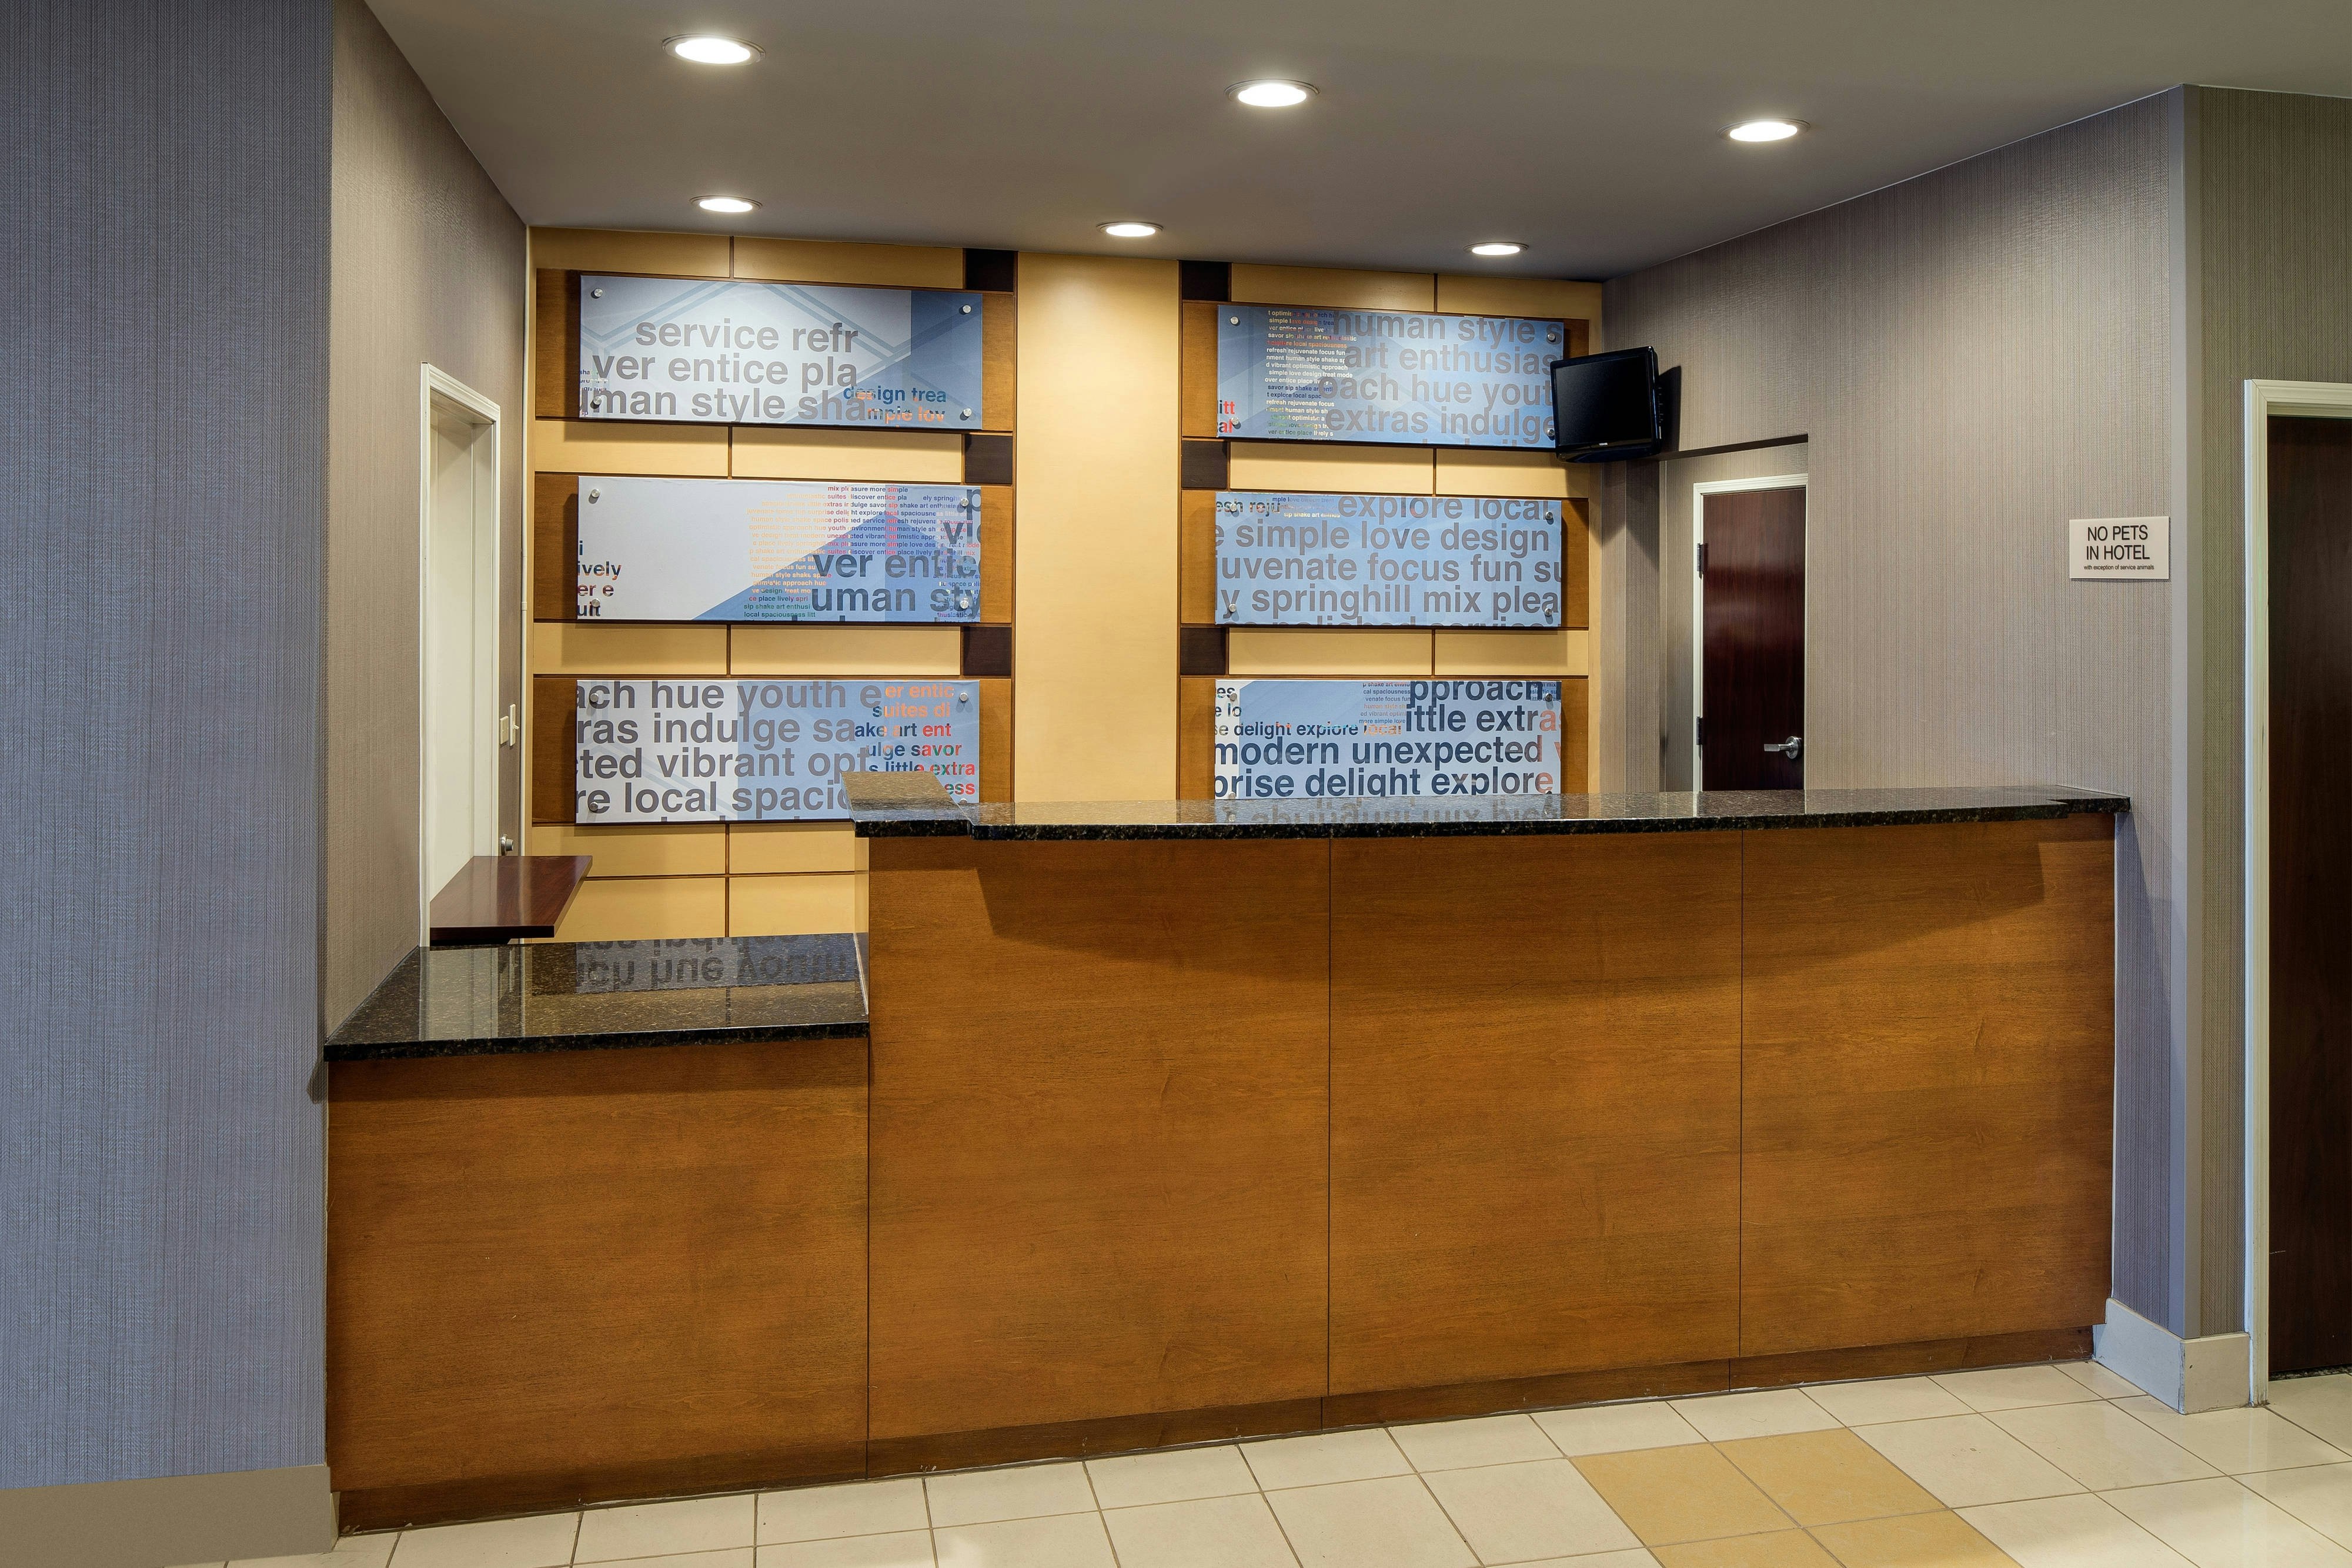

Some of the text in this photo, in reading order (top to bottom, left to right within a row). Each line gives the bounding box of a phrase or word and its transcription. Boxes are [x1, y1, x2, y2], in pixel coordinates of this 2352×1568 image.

[635, 318, 857, 352] service refr
[1335, 312, 1535, 350] human style
[1345, 343, 1388, 369] art
[592, 352, 857, 393] ver entice pla
[843, 386, 946, 404] design trea
[1318, 372, 1398, 401] oach
[1412, 375, 1471, 403] hue
[691, 386, 786, 423] style
[918, 406, 946, 422] lov
[1326, 407, 1429, 434] extras
[1338, 495, 1462, 524] explore
[1236, 519, 1349, 555] simple
[1362, 521, 1429, 551] love
[1441, 523, 1549, 559] design
[2087, 524, 2148, 541] NO PETS
[814, 553, 873, 578] ver
[884, 549, 981, 579] entic
[2087, 544, 2150, 560] IN HOTEL
[1368, 553, 1459, 581] focus
[1471, 554, 1522, 582] fun
[812, 588, 915, 612] uman
[1252, 583, 1409, 620] springhill
[1424, 586, 1481, 613] mix
[652, 682, 724, 708] hue
[737, 681, 846, 716] youth
[860, 684, 881, 708] e
[884, 683, 954, 698] er entic
[872, 703, 950, 718] suites di
[1228, 703, 1242, 717] lo
[1406, 704, 1466, 732] ittle
[653, 713, 800, 750] indulge
[813, 718, 855, 742] sa
[854, 723, 951, 738] ake art ent
[1234, 721, 1402, 739] delight explore local
[657, 747, 795, 778] vibrant
[911, 744, 961, 756] savor
[1215, 735, 1543, 770] modern unexpected
[930, 763, 975, 776] extra
[1305, 767, 1420, 797] delight
[1431, 767, 1553, 795] explore
[626, 783, 717, 813] local
